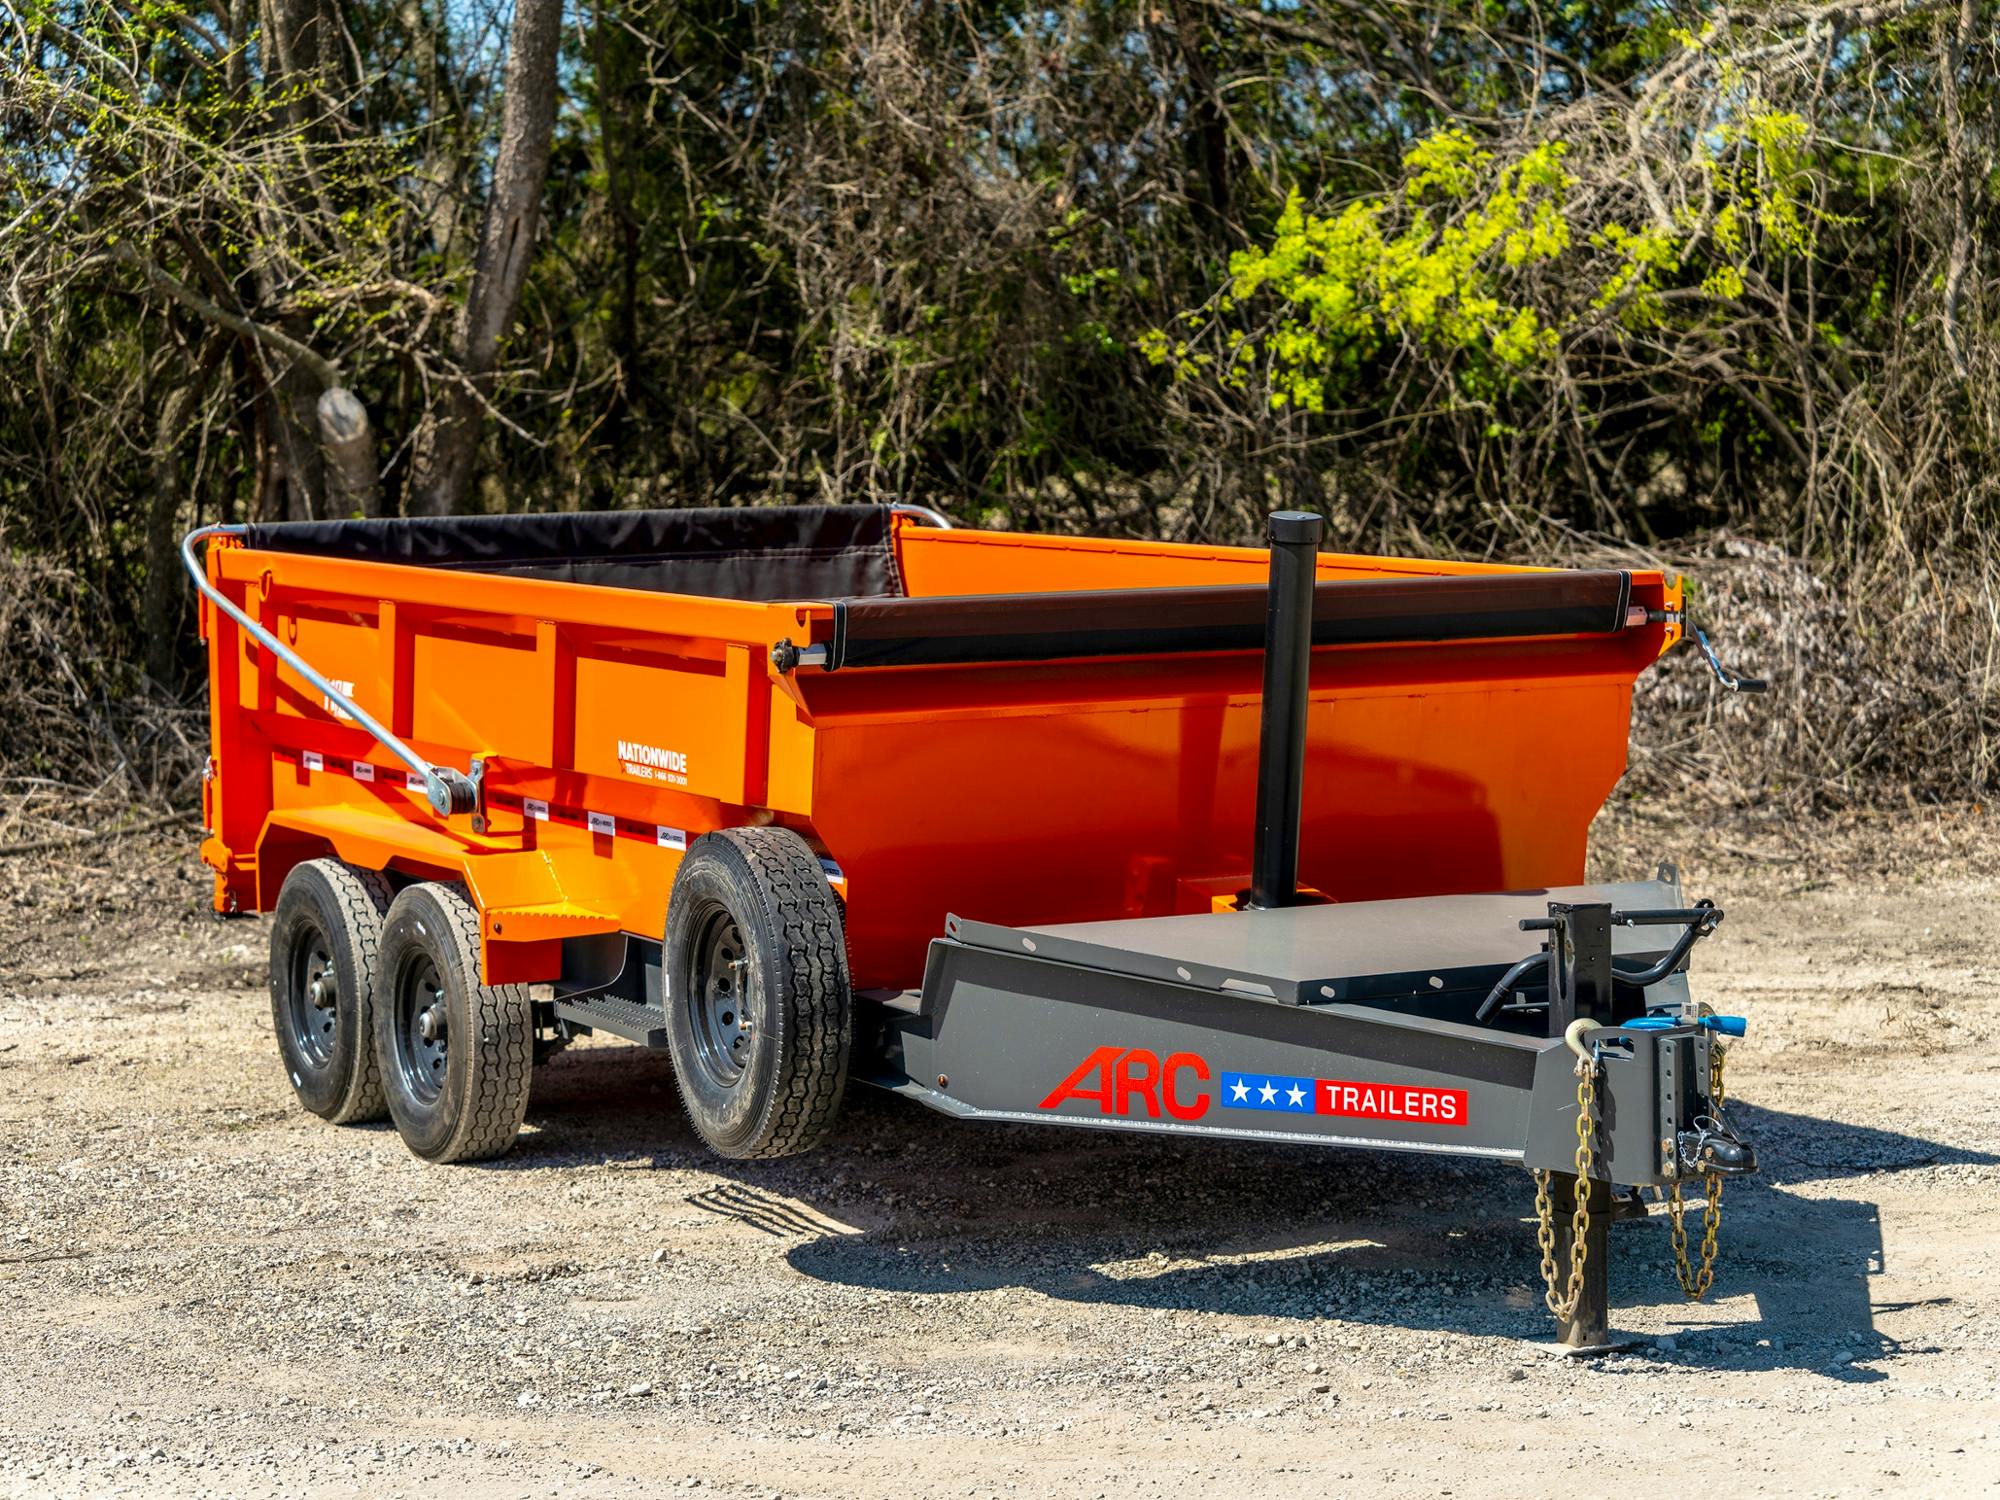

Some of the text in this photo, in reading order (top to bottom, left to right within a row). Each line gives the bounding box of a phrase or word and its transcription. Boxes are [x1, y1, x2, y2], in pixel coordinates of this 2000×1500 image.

[618, 740, 687, 773] NATIONWIDE
[625, 762, 653, 779] TRAILERS
[1040, 1046, 1457, 1120] ARC TRAILERS
